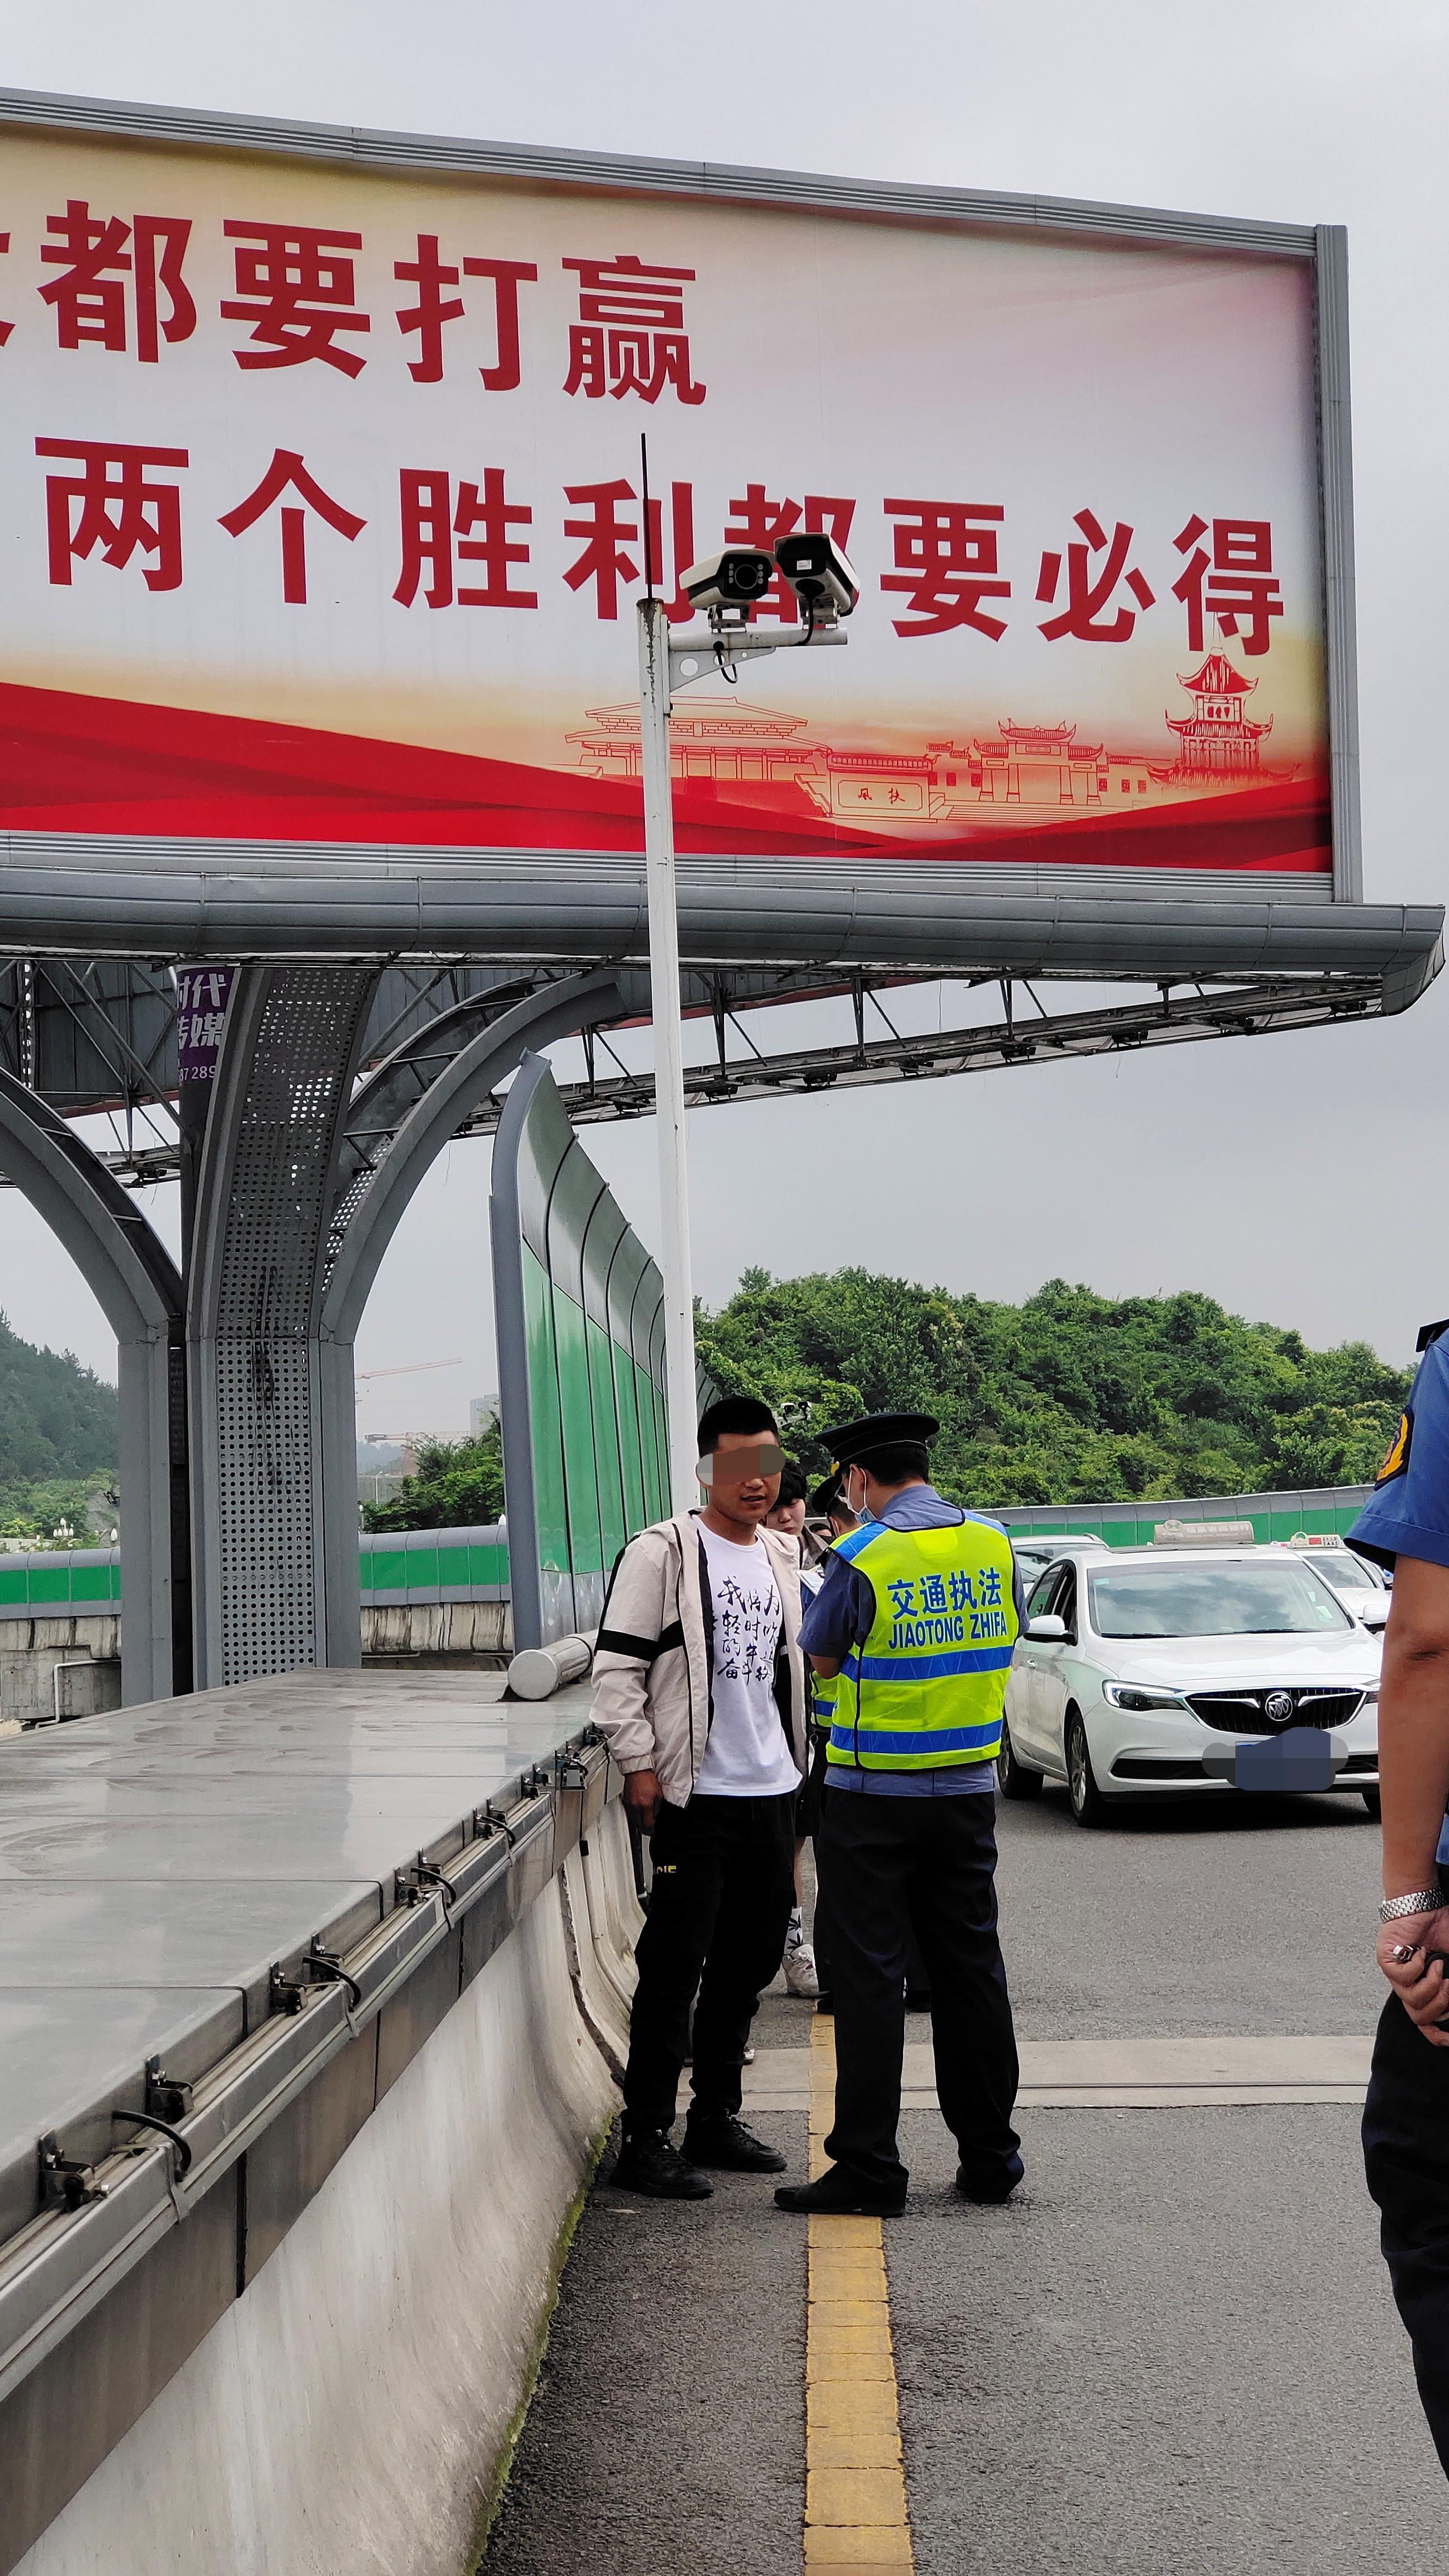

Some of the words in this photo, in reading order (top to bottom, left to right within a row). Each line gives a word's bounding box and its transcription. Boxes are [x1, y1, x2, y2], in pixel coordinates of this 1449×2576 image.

[0, 200, 706, 405] 都要打赢
[887, 1567, 1003, 1620] 交通执法
[713, 1610, 778, 1646] 轻时吹
[888, 1616, 964, 1649] JIAOTONG
[971, 1612, 1007, 1640] ZHIFA
